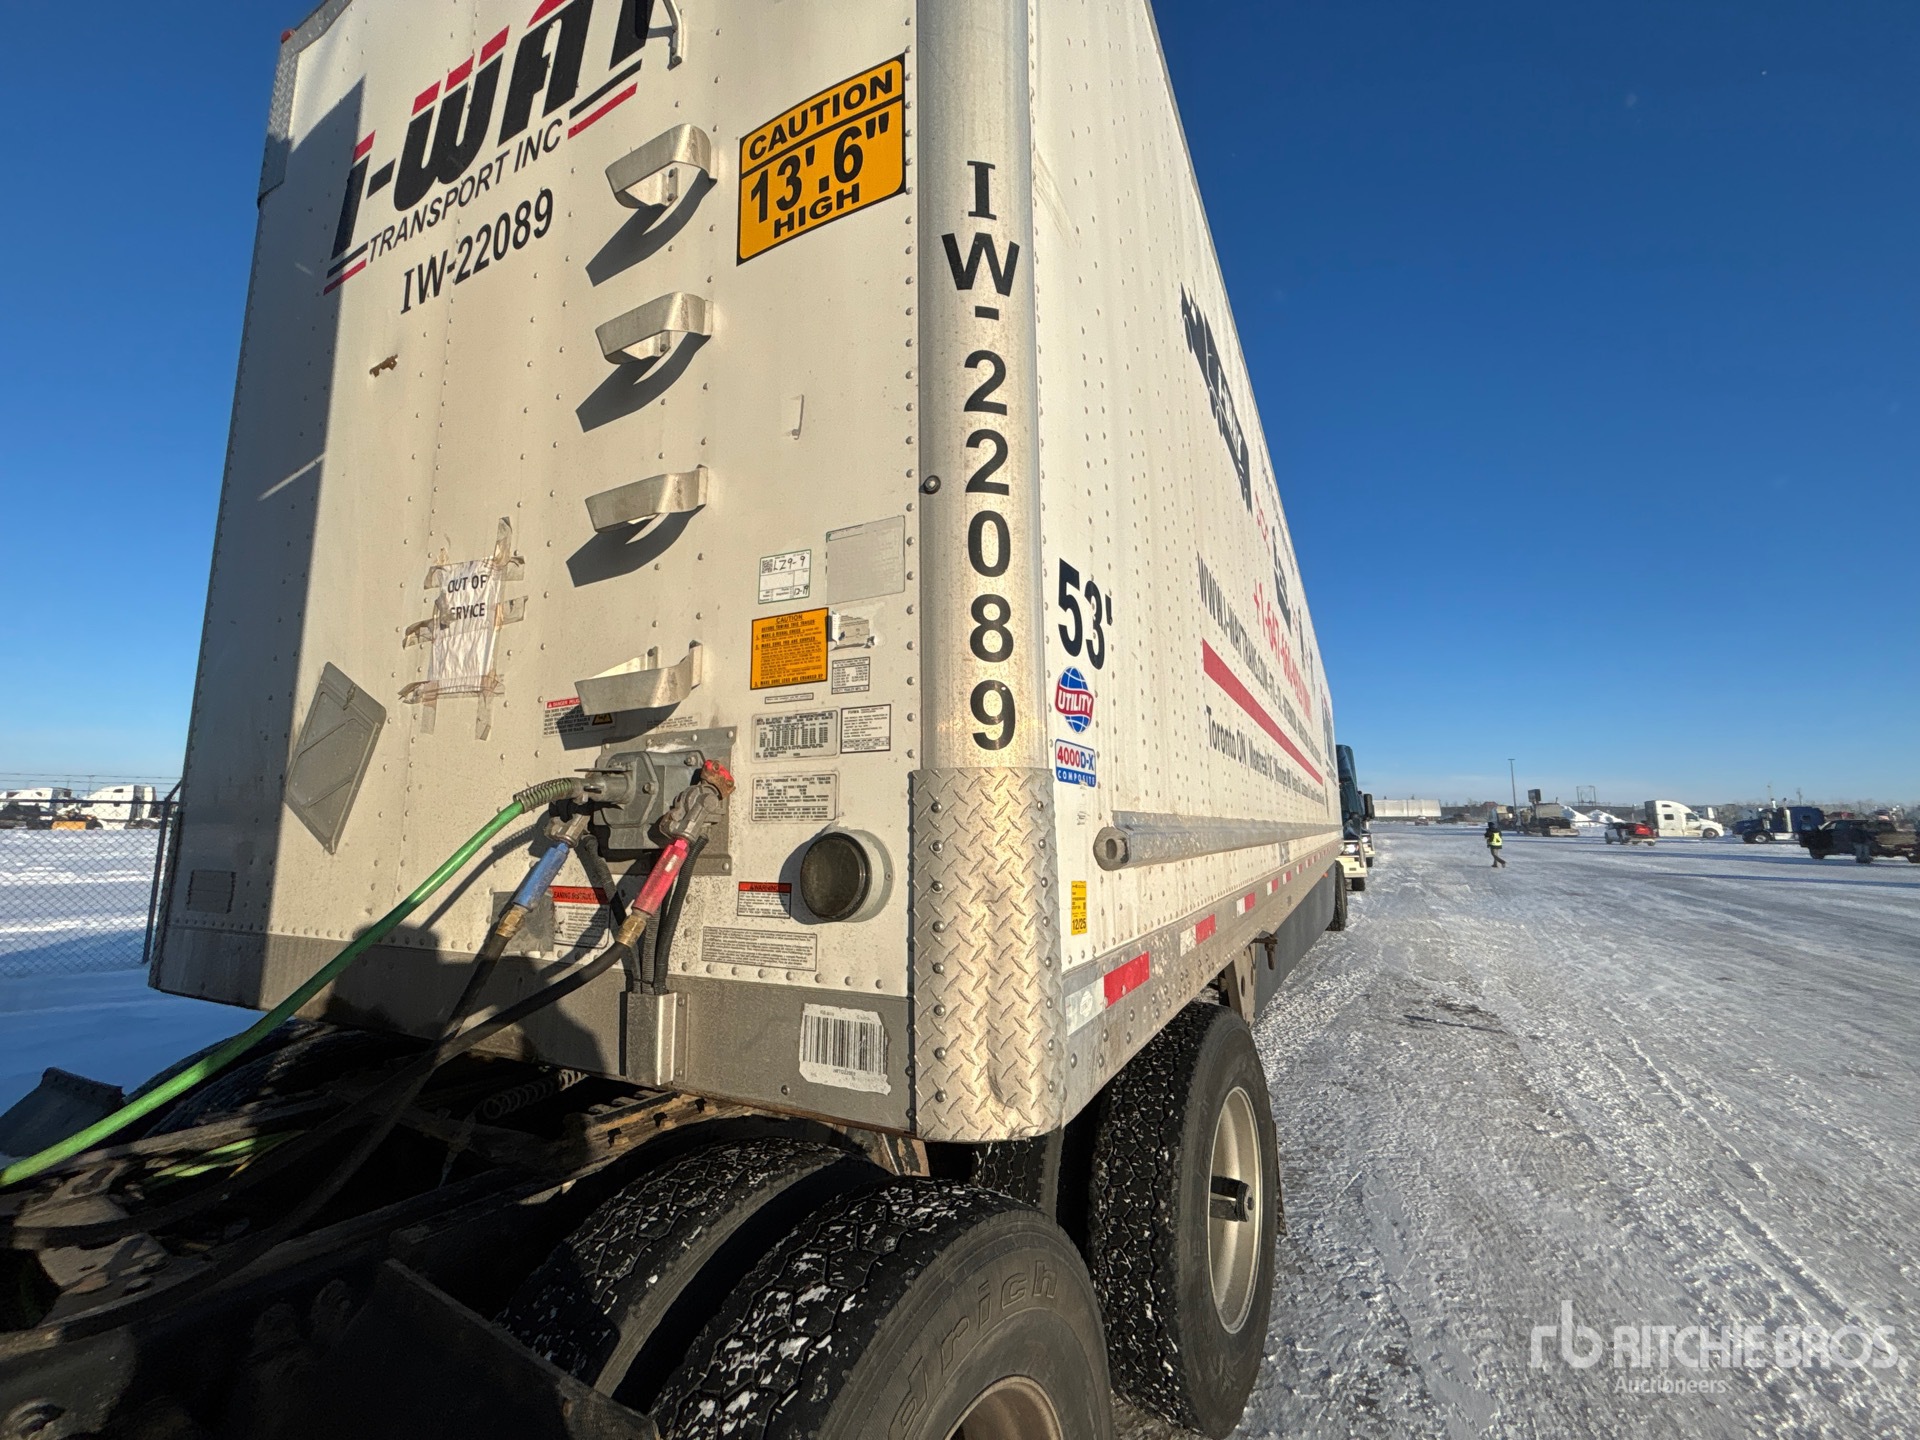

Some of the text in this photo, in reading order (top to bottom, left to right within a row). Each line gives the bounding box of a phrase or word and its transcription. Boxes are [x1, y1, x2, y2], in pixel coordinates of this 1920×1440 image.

[749, 68, 893, 160] CAUTION
[370, 119, 563, 263] TRANSPORT INC
[773, 182, 860, 239] HIGH
[400, 188, 554, 314] IW-22089
[447, 575, 487, 593] OUT OF
[450, 602, 486, 620] ERVICE
[776, 614, 803, 624] CAUTION
[1058, 558, 1112, 670] 53'
[1058, 689, 1092, 714] UTILITY
[1206, 704, 1236, 760] Toronto
[1057, 745, 1095, 771] 4000D-X
[1057, 769, 1096, 785] COMPOSITE
